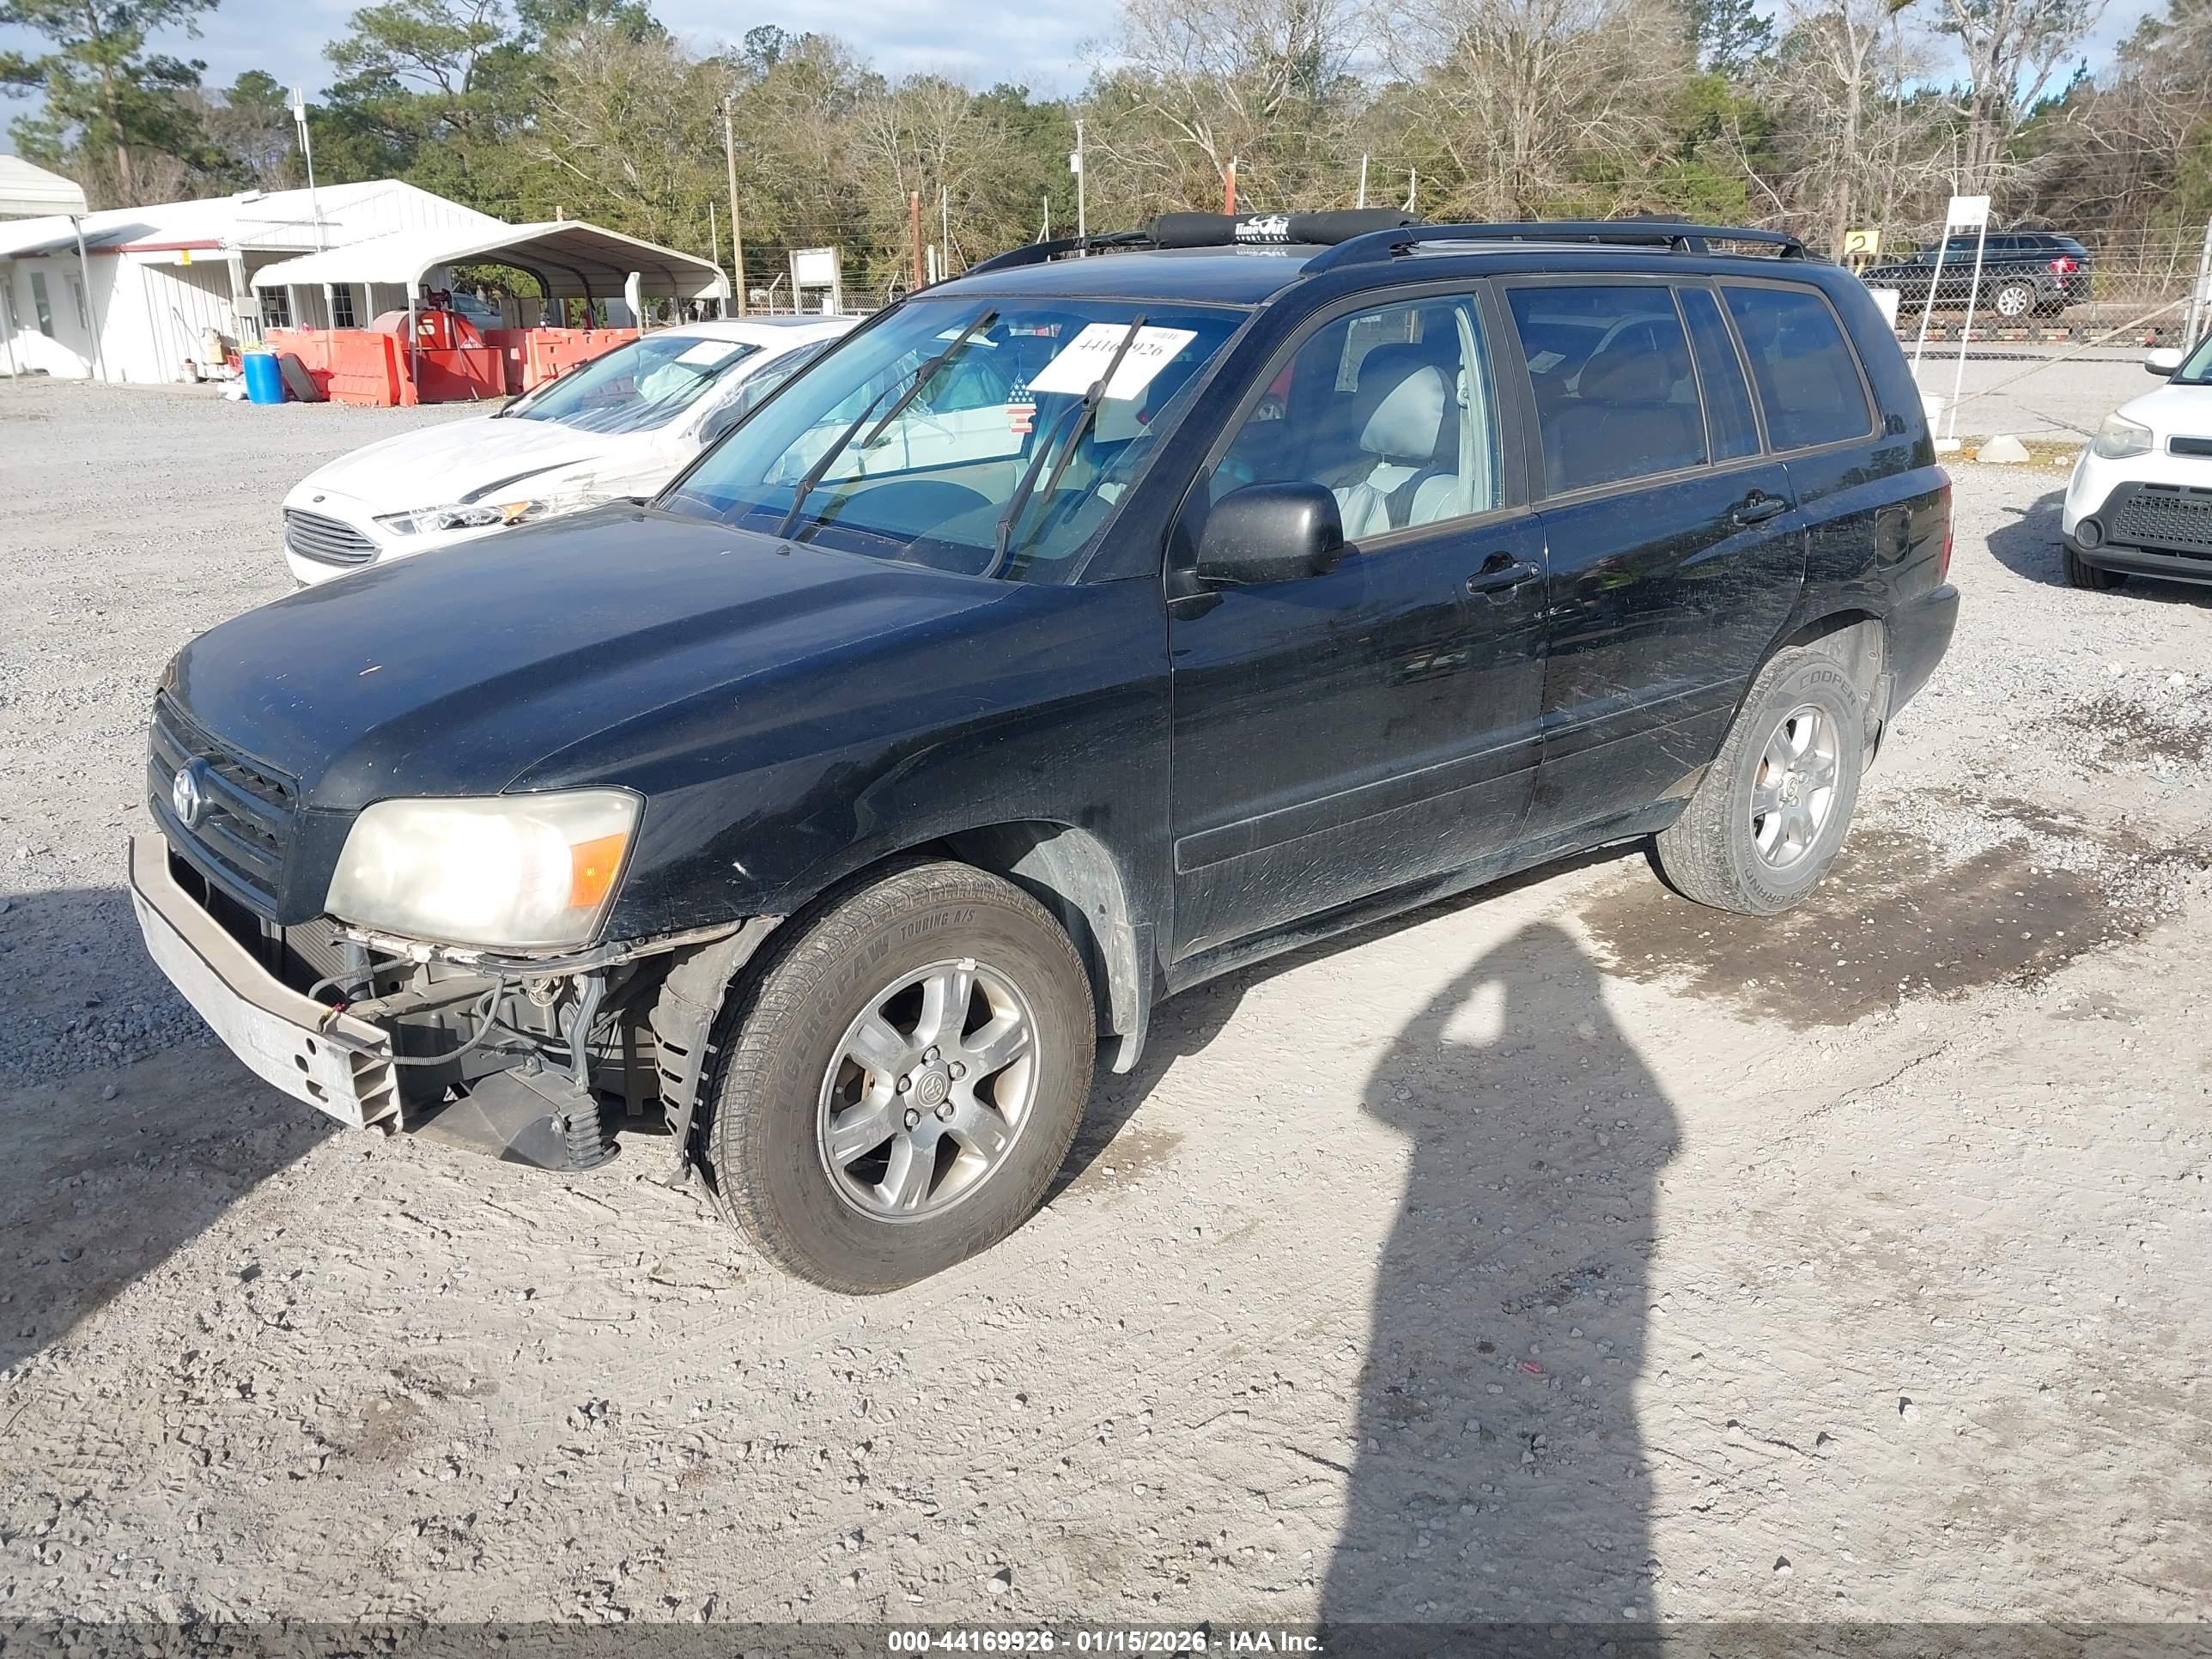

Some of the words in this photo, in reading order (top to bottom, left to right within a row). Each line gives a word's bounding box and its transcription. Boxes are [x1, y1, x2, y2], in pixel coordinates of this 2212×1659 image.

[1849, 234, 1870, 253] 2
[1079, 338, 1164, 356] 4416926
[1799, 671, 1856, 706] COOPER
[832, 935, 891, 996] PAW
[900, 912, 949, 941] TOURING
[953, 908, 976, 924] A/S
